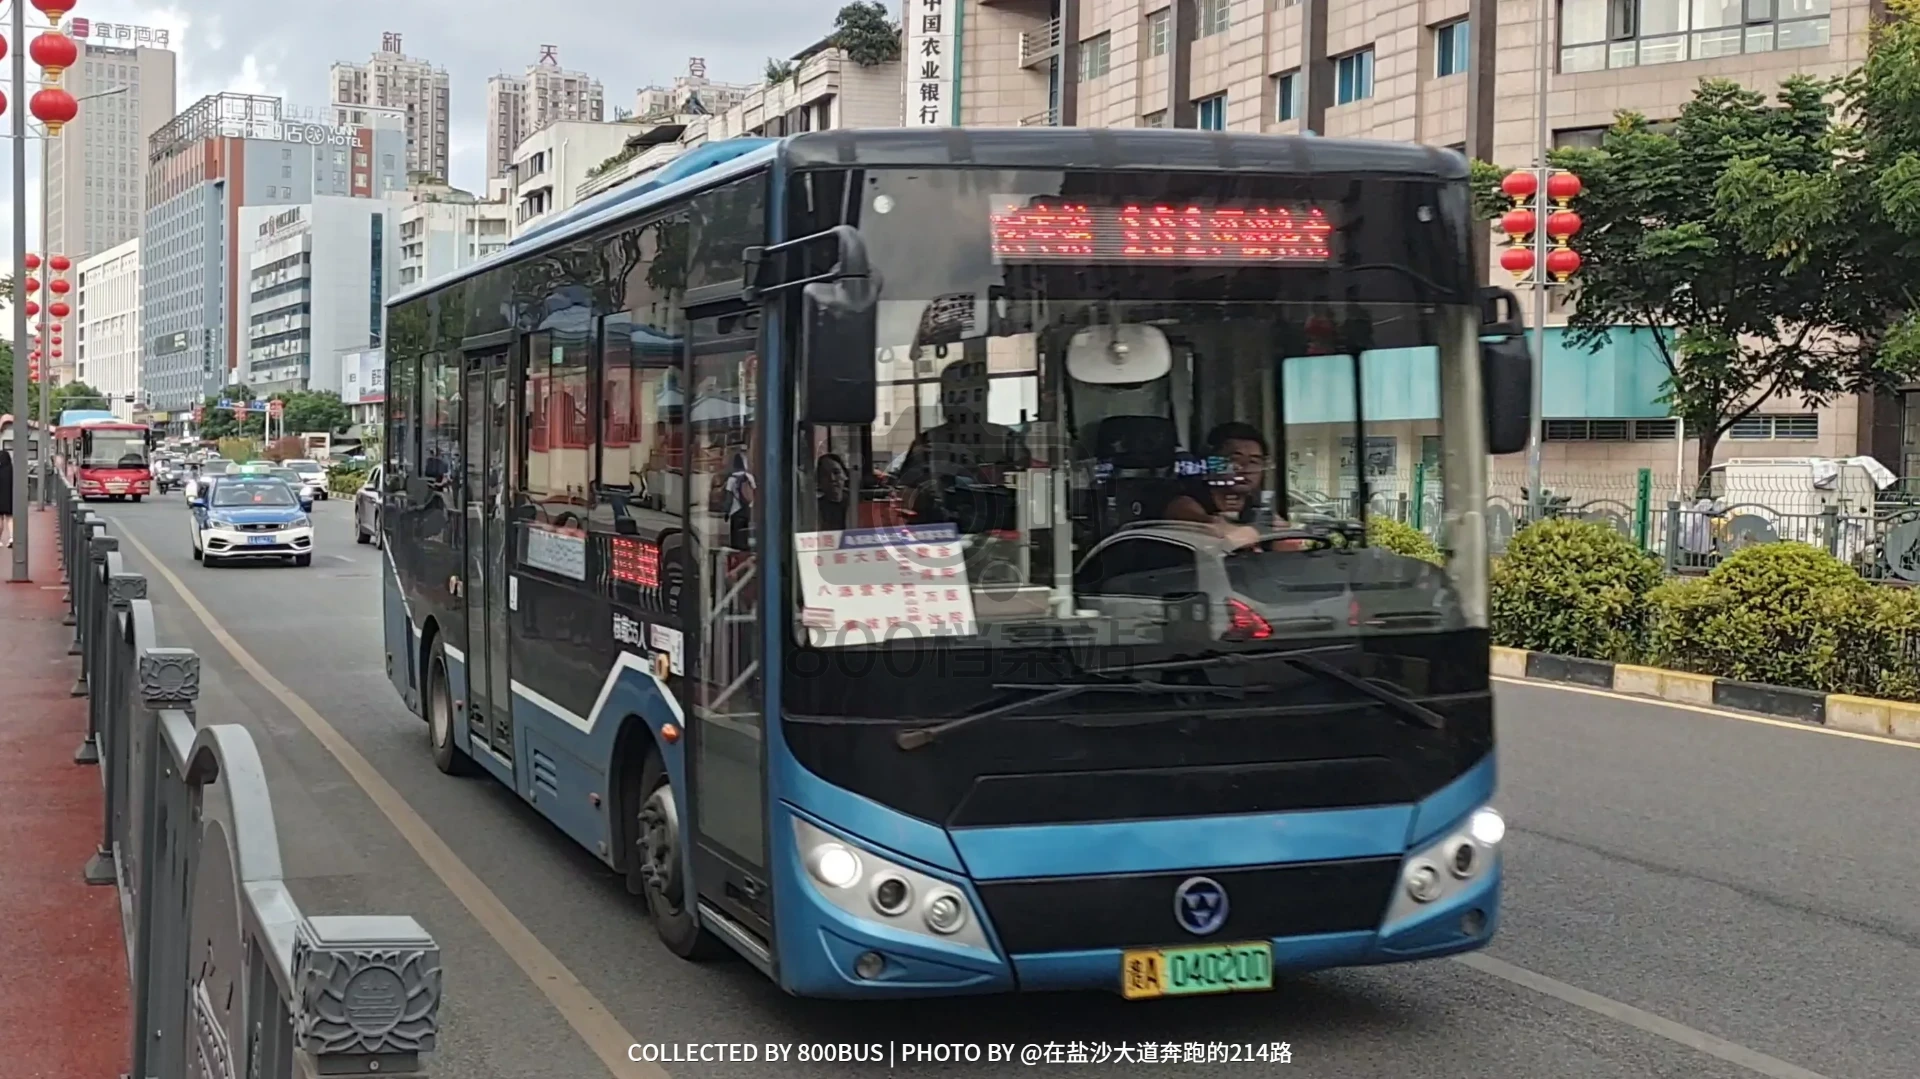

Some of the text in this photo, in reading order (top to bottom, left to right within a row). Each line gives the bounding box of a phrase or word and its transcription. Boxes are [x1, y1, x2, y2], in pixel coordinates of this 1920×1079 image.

[94, 22, 169, 45] 宜尚酒店
[382, 31, 402, 54] 新
[539, 44, 558, 66] 天
[919, 0, 941, 124] 中国农业银行
[327, 135, 364, 148] HOTEL
